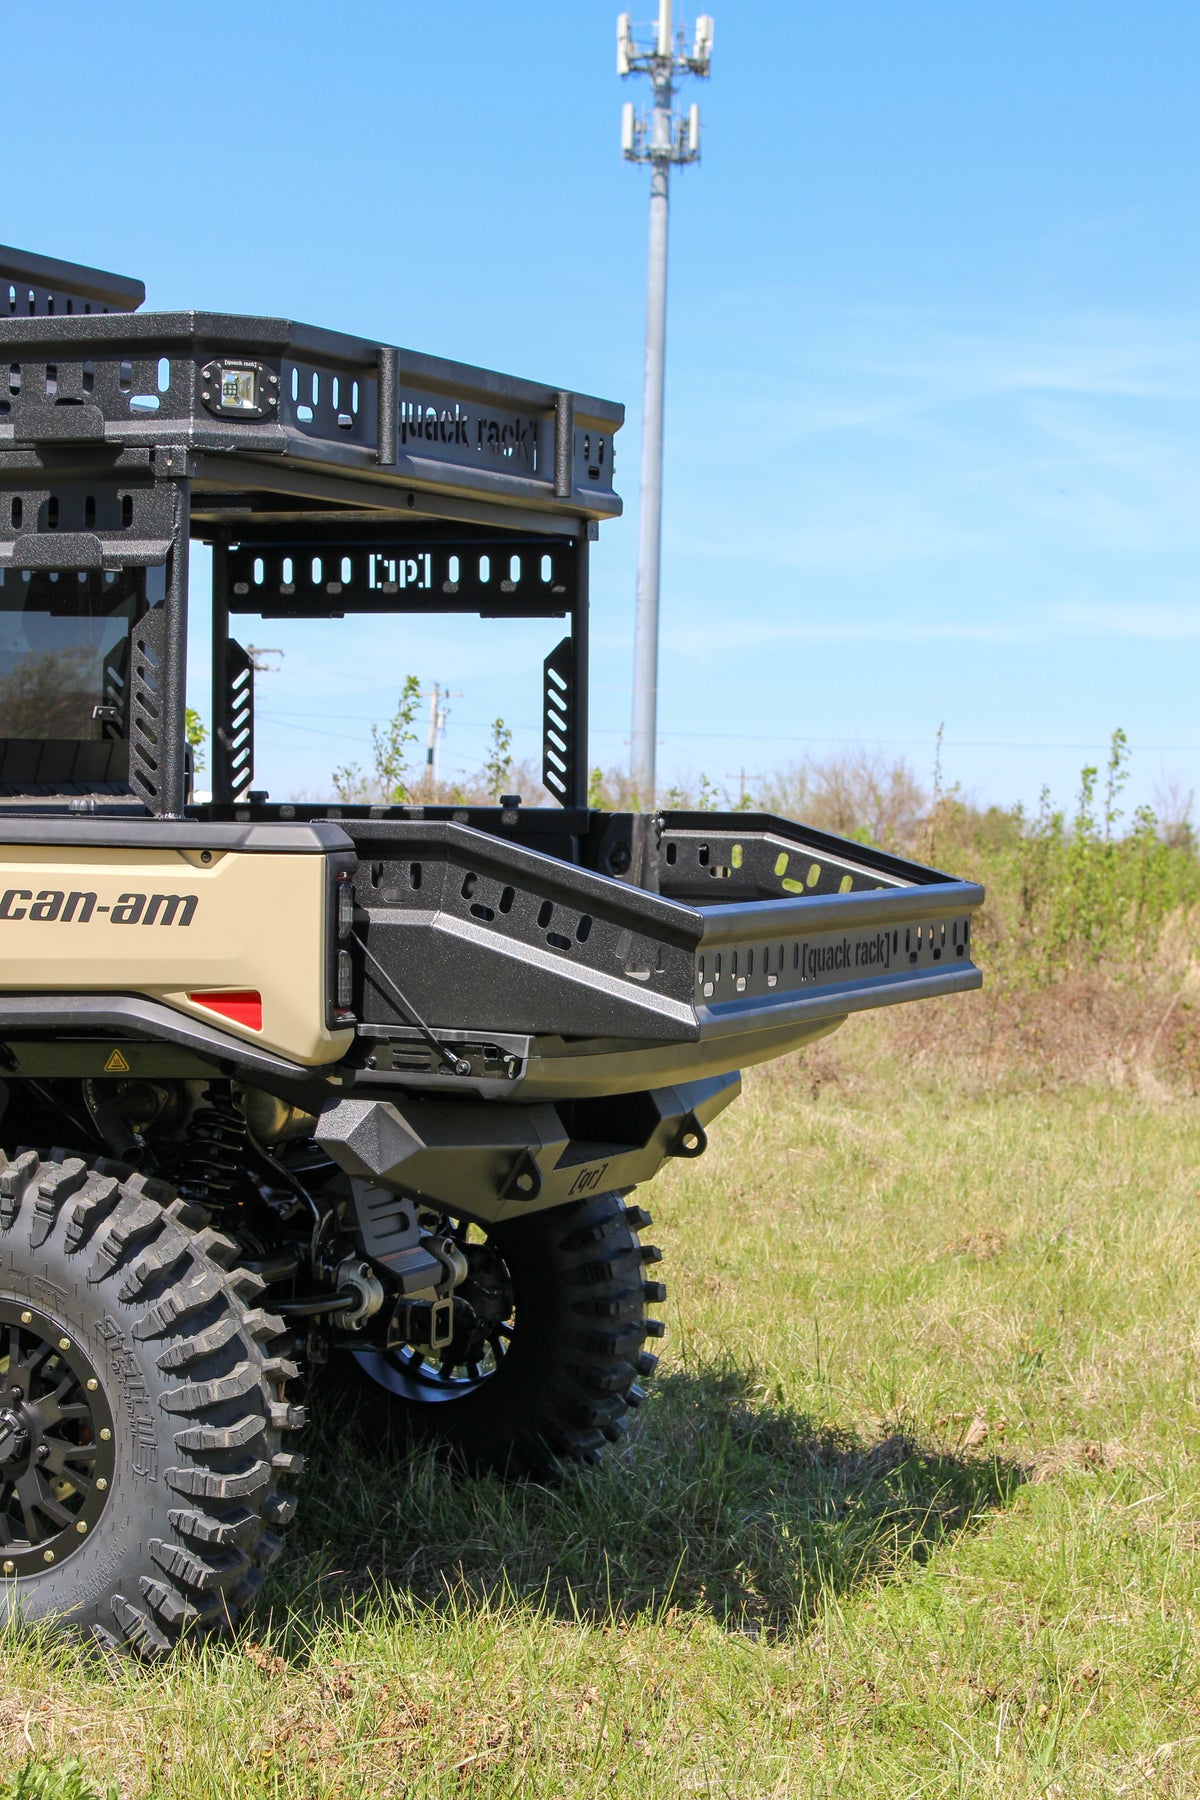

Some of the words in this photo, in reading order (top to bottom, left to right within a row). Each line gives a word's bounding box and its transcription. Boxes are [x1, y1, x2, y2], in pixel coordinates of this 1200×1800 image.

[0, 889, 199, 926] can-am
[802, 938, 851, 981] [quack
[855, 931, 890, 968] rack]
